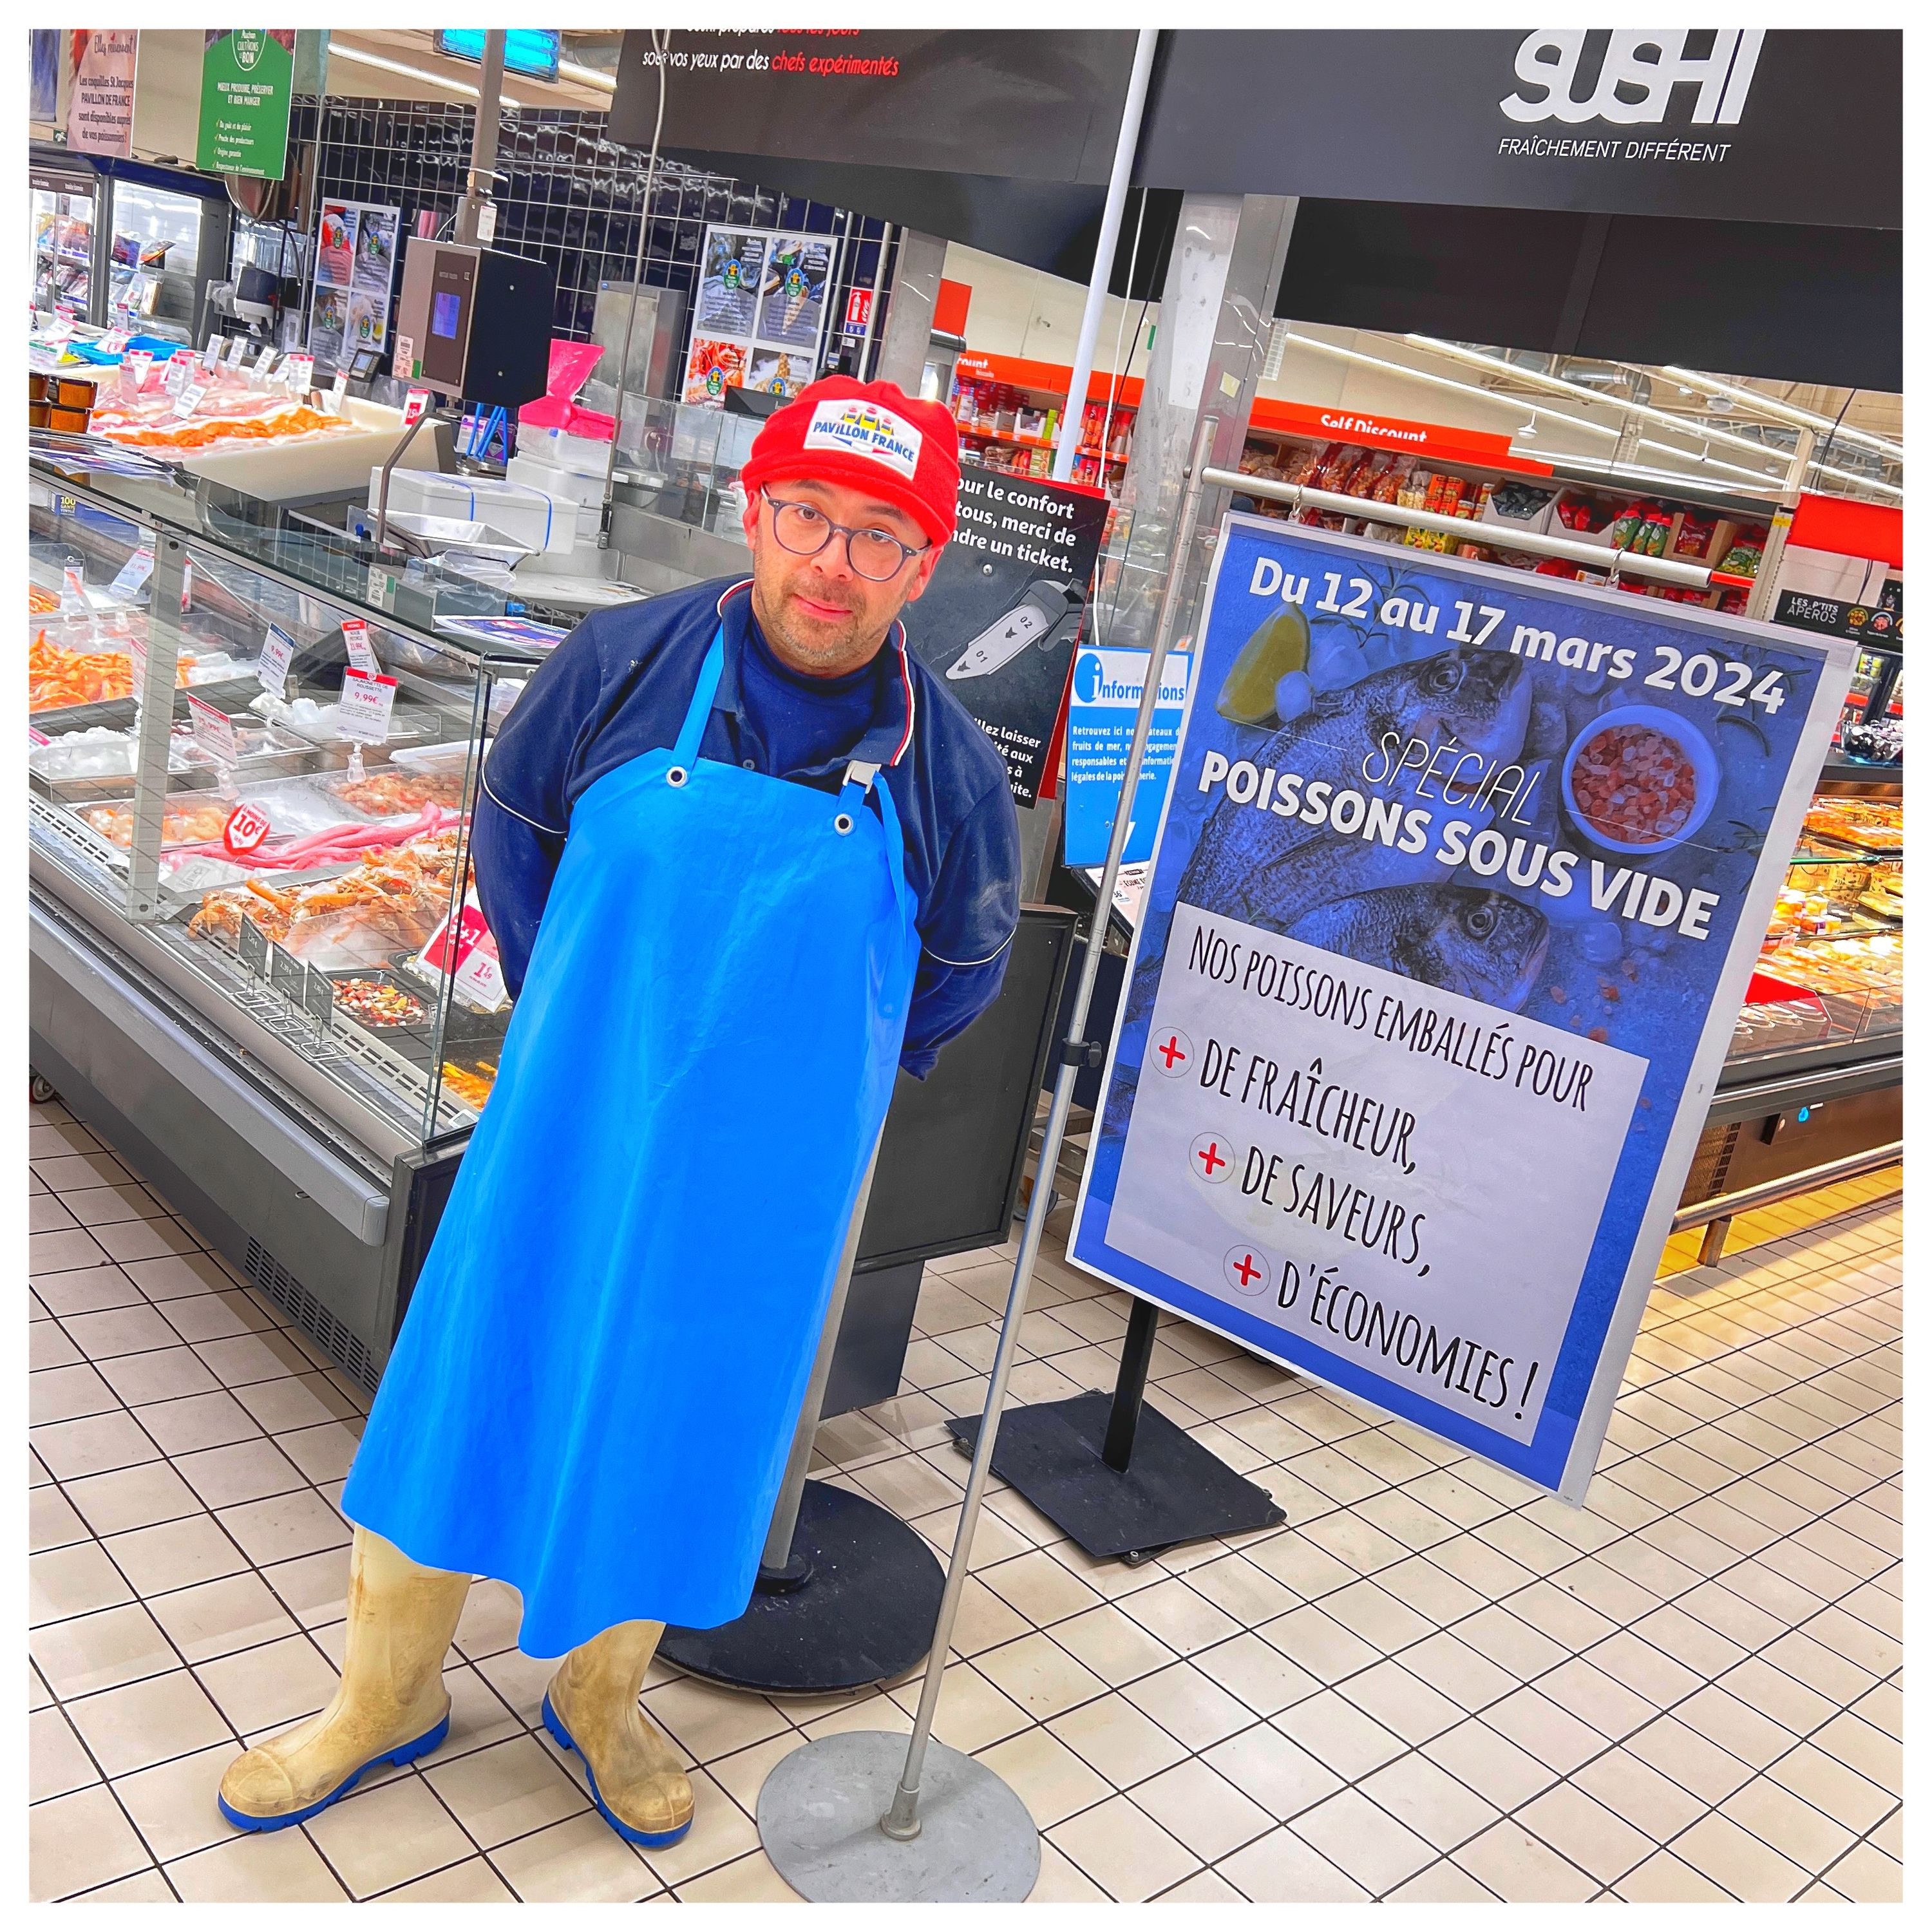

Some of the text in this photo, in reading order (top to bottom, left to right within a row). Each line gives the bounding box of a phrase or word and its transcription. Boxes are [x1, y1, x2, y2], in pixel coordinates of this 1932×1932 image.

[670, 52, 688, 67] vos
[690, 53, 719, 71] yeux
[719, 53, 745, 72] par
[746, 49, 770, 70] des
[772, 50, 806, 71] chefs
[809, 54, 899, 77] expérimentés
[1499, 29, 1767, 124] SUSHI
[81, 92, 130, 106] PAVILLON DE FRANCE
[1498, 135, 1732, 162] FRAÎCHEMENT DIFFÉRENT
[872, 433, 914, 462] FRANCE
[61, 497, 76, 506] 100
[957, 478, 1075, 520] our le confort
[955, 500, 1077, 547] tous, merci de
[951, 528, 1073, 573] ndre un ticket.
[1791, 596, 1808, 607] LES
[1019, 616, 1034, 629] 02
[1249, 556, 1785, 714] Du 12 au 17 mars 2024
[976, 650, 989, 663] 01
[1001, 726, 1041, 748] laisser
[1073, 726, 1111, 736] Retrouvez
[1113, 726, 1122, 736] ici
[1126, 728, 1134, 736] no
[1148, 727, 1173, 736] ateaux
[1010, 750, 1034, 764] aux
[1072, 741, 1092, 751] fruits
[1095, 741, 1104, 751] de
[1106, 743, 1122, 752] mer,
[1014, 765, 1023, 778] à
[1072, 755, 1117, 768] responsables
[1119, 757, 1127, 766] et
[1072, 772, 1095, 784] légales
[1096, 772, 1104, 781] de
[1106, 772, 1112, 781] la
[1362, 732, 1540, 826] SPÉCIAL
[1198, 750, 1720, 940] POISSONS SOUS VIDE
[1243, 954, 1372, 1030] POISSONS
[1375, 995, 1514, 1081] EMBALLÉS
[1516, 1045, 1593, 1112] POUR
[1199, 1038, 1242, 1098] DE
[1241, 1057, 1417, 1175] FRAÎCHEUR,
[1242, 1146, 1284, 1206] DE
[1283, 1164, 1431, 1277] SAVEURS,
[1278, 1260, 1515, 1408] D'ÉCONOMIES
